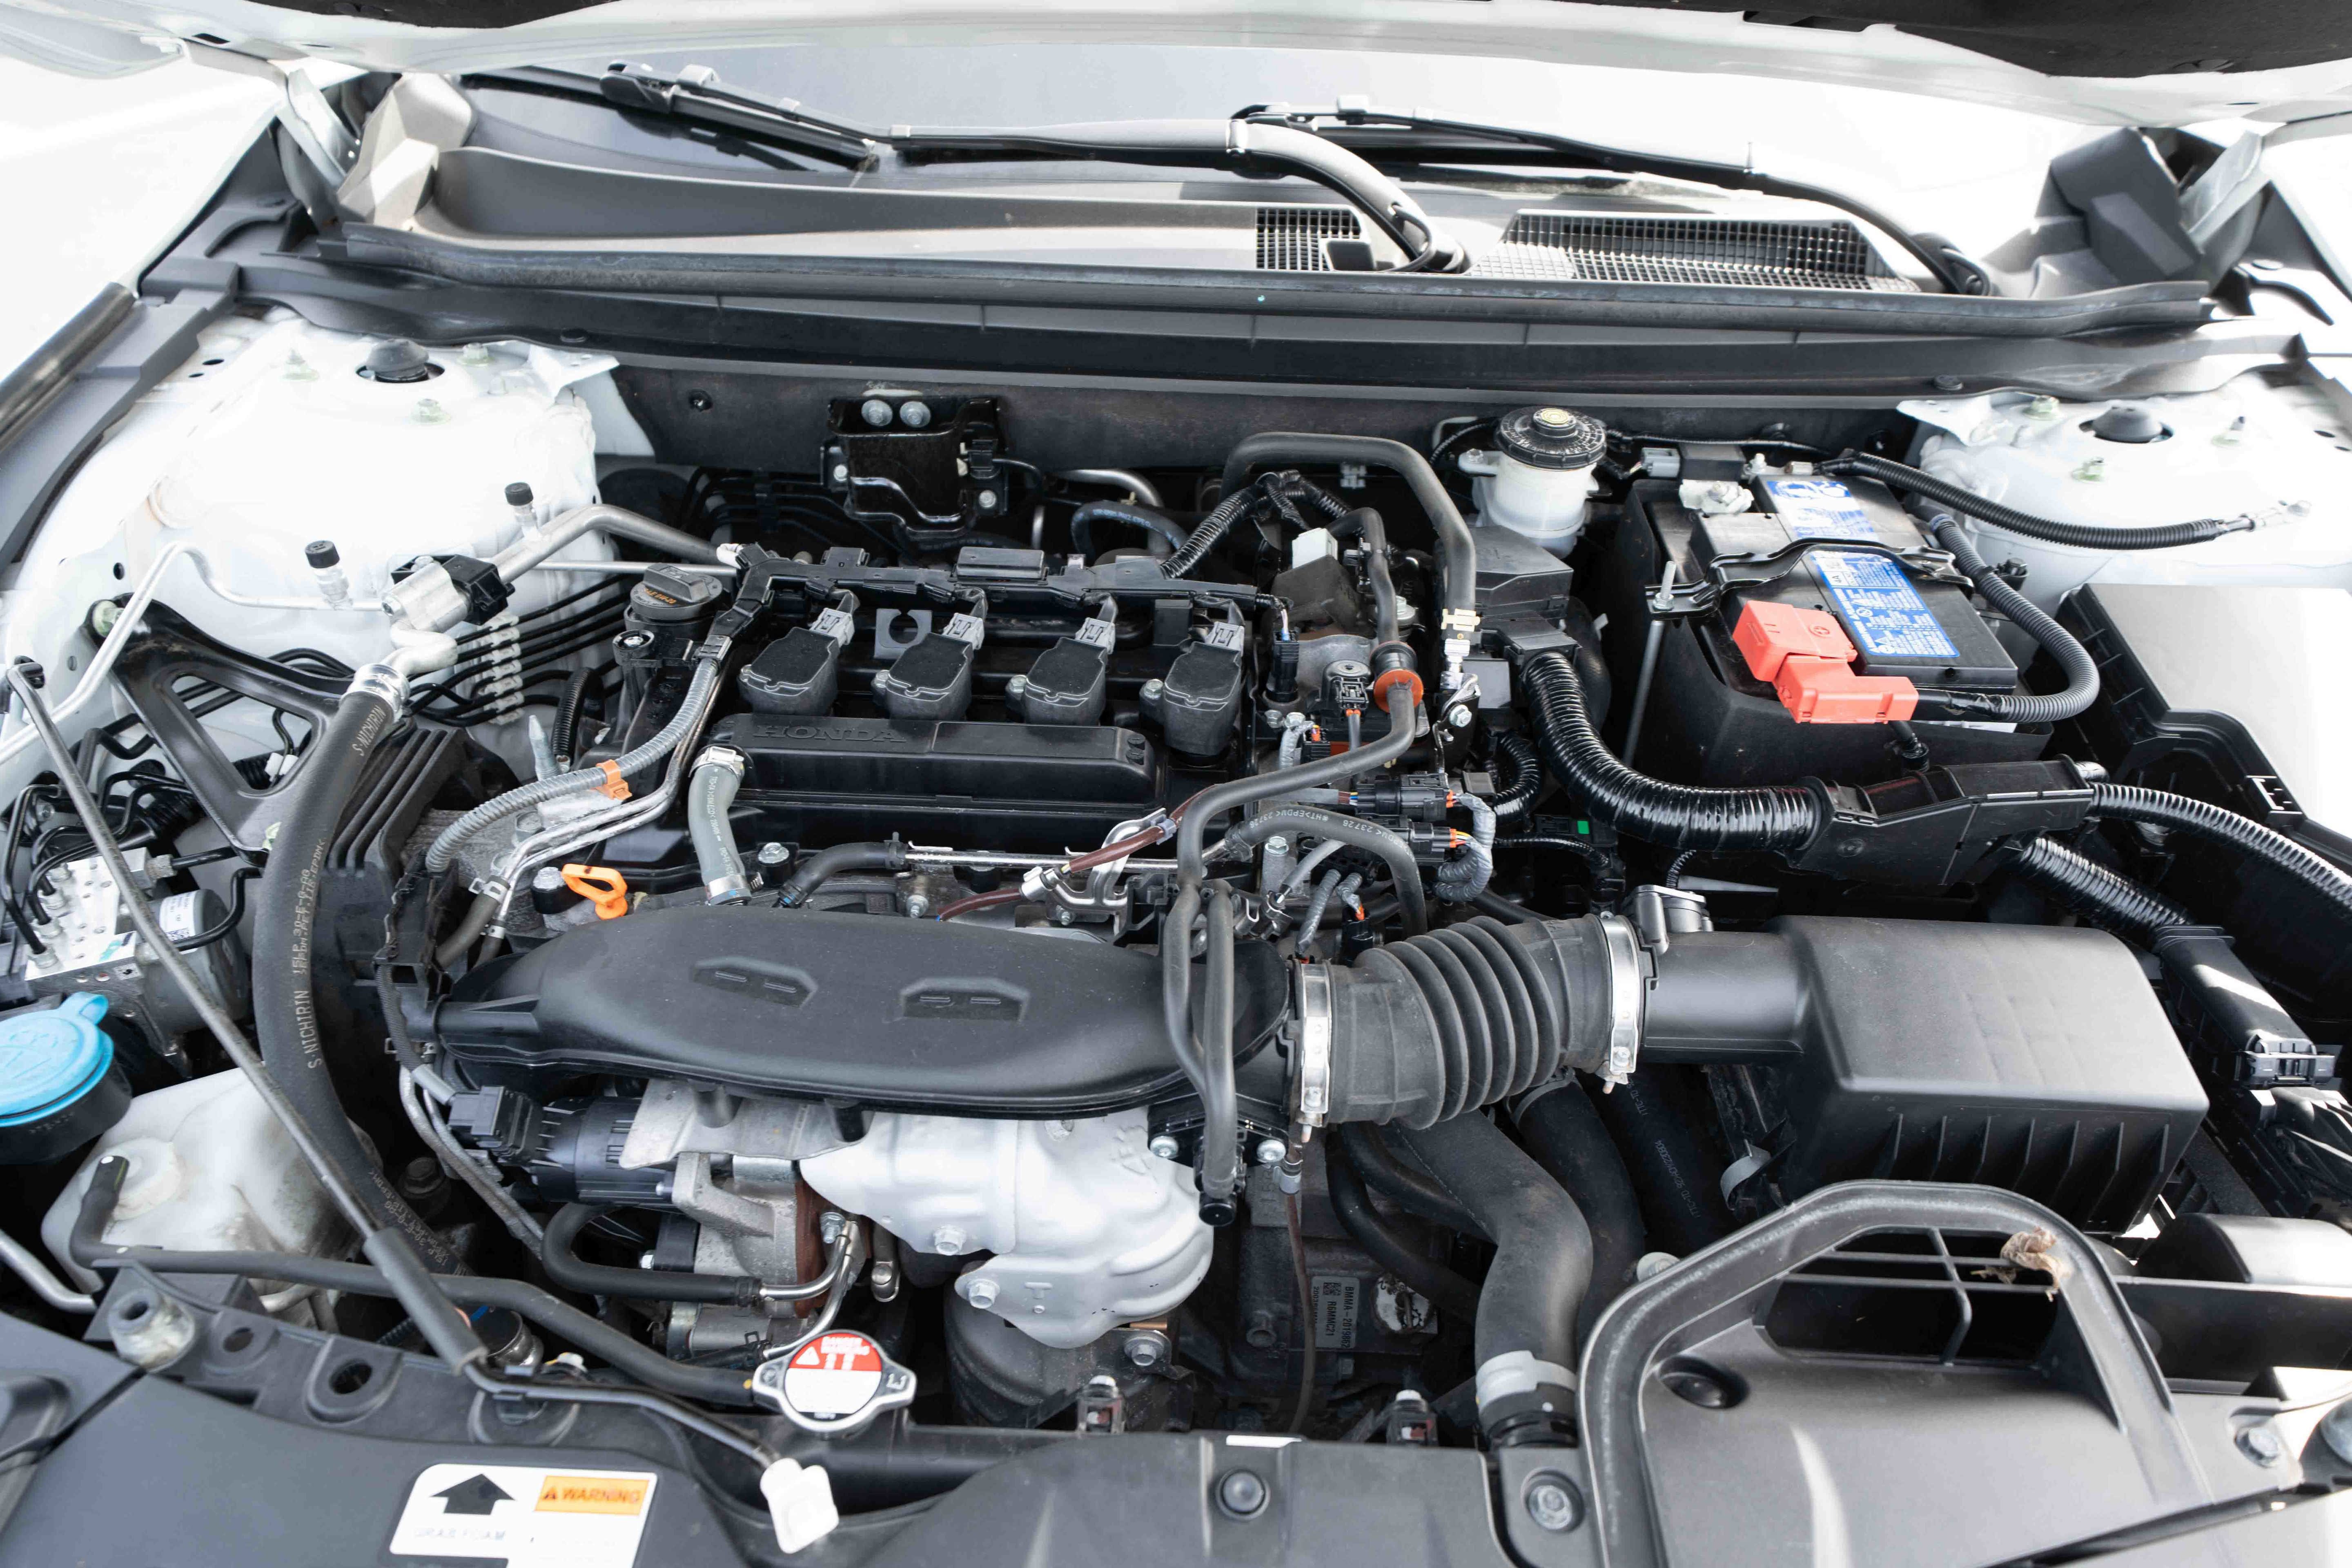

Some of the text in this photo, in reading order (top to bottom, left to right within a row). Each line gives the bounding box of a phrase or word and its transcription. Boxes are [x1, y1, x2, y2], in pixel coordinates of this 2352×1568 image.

[654, 594, 677, 604] 0W-20
[753, 725, 906, 742] HONDA
[1343, 1286, 1354, 1310] BMMA
[561, 1486, 641, 1504] WARNING
